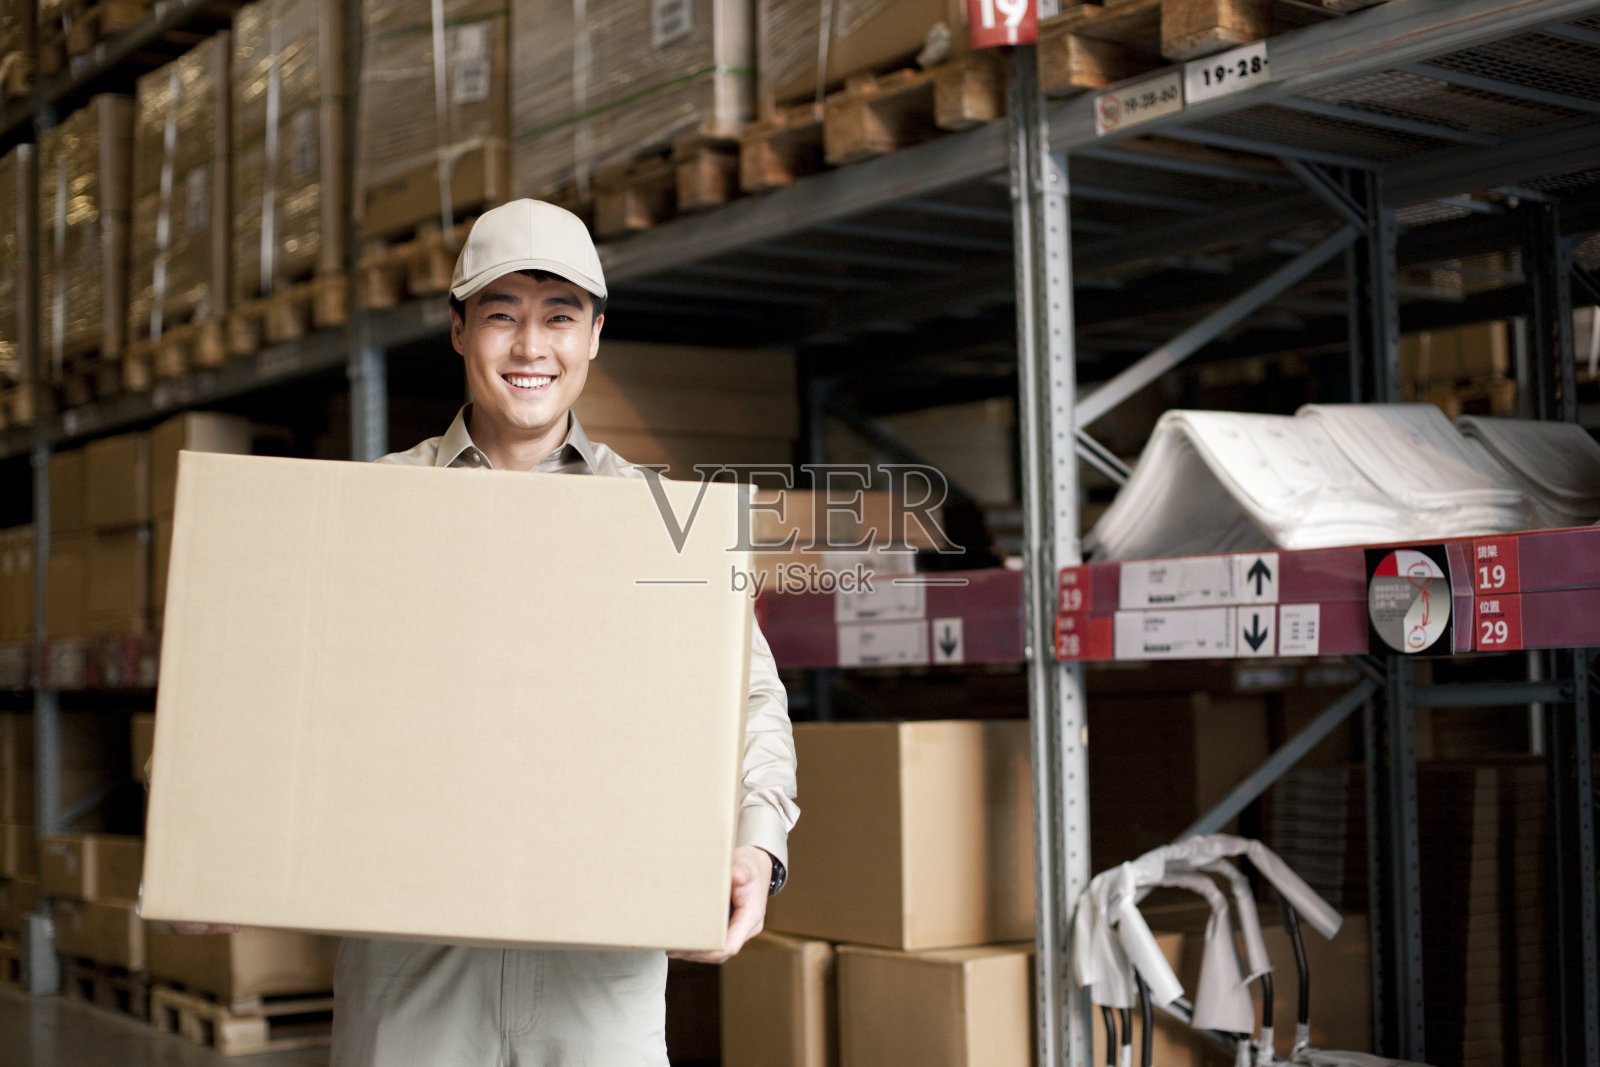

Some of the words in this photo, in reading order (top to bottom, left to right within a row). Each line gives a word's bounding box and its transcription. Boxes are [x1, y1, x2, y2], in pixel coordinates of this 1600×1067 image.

[980, 0, 1028, 29] 19
[1479, 565, 1506, 589] 19
[1062, 588, 1082, 611] 19
[1481, 620, 1508, 644] 29
[1059, 633, 1080, 656] 28
